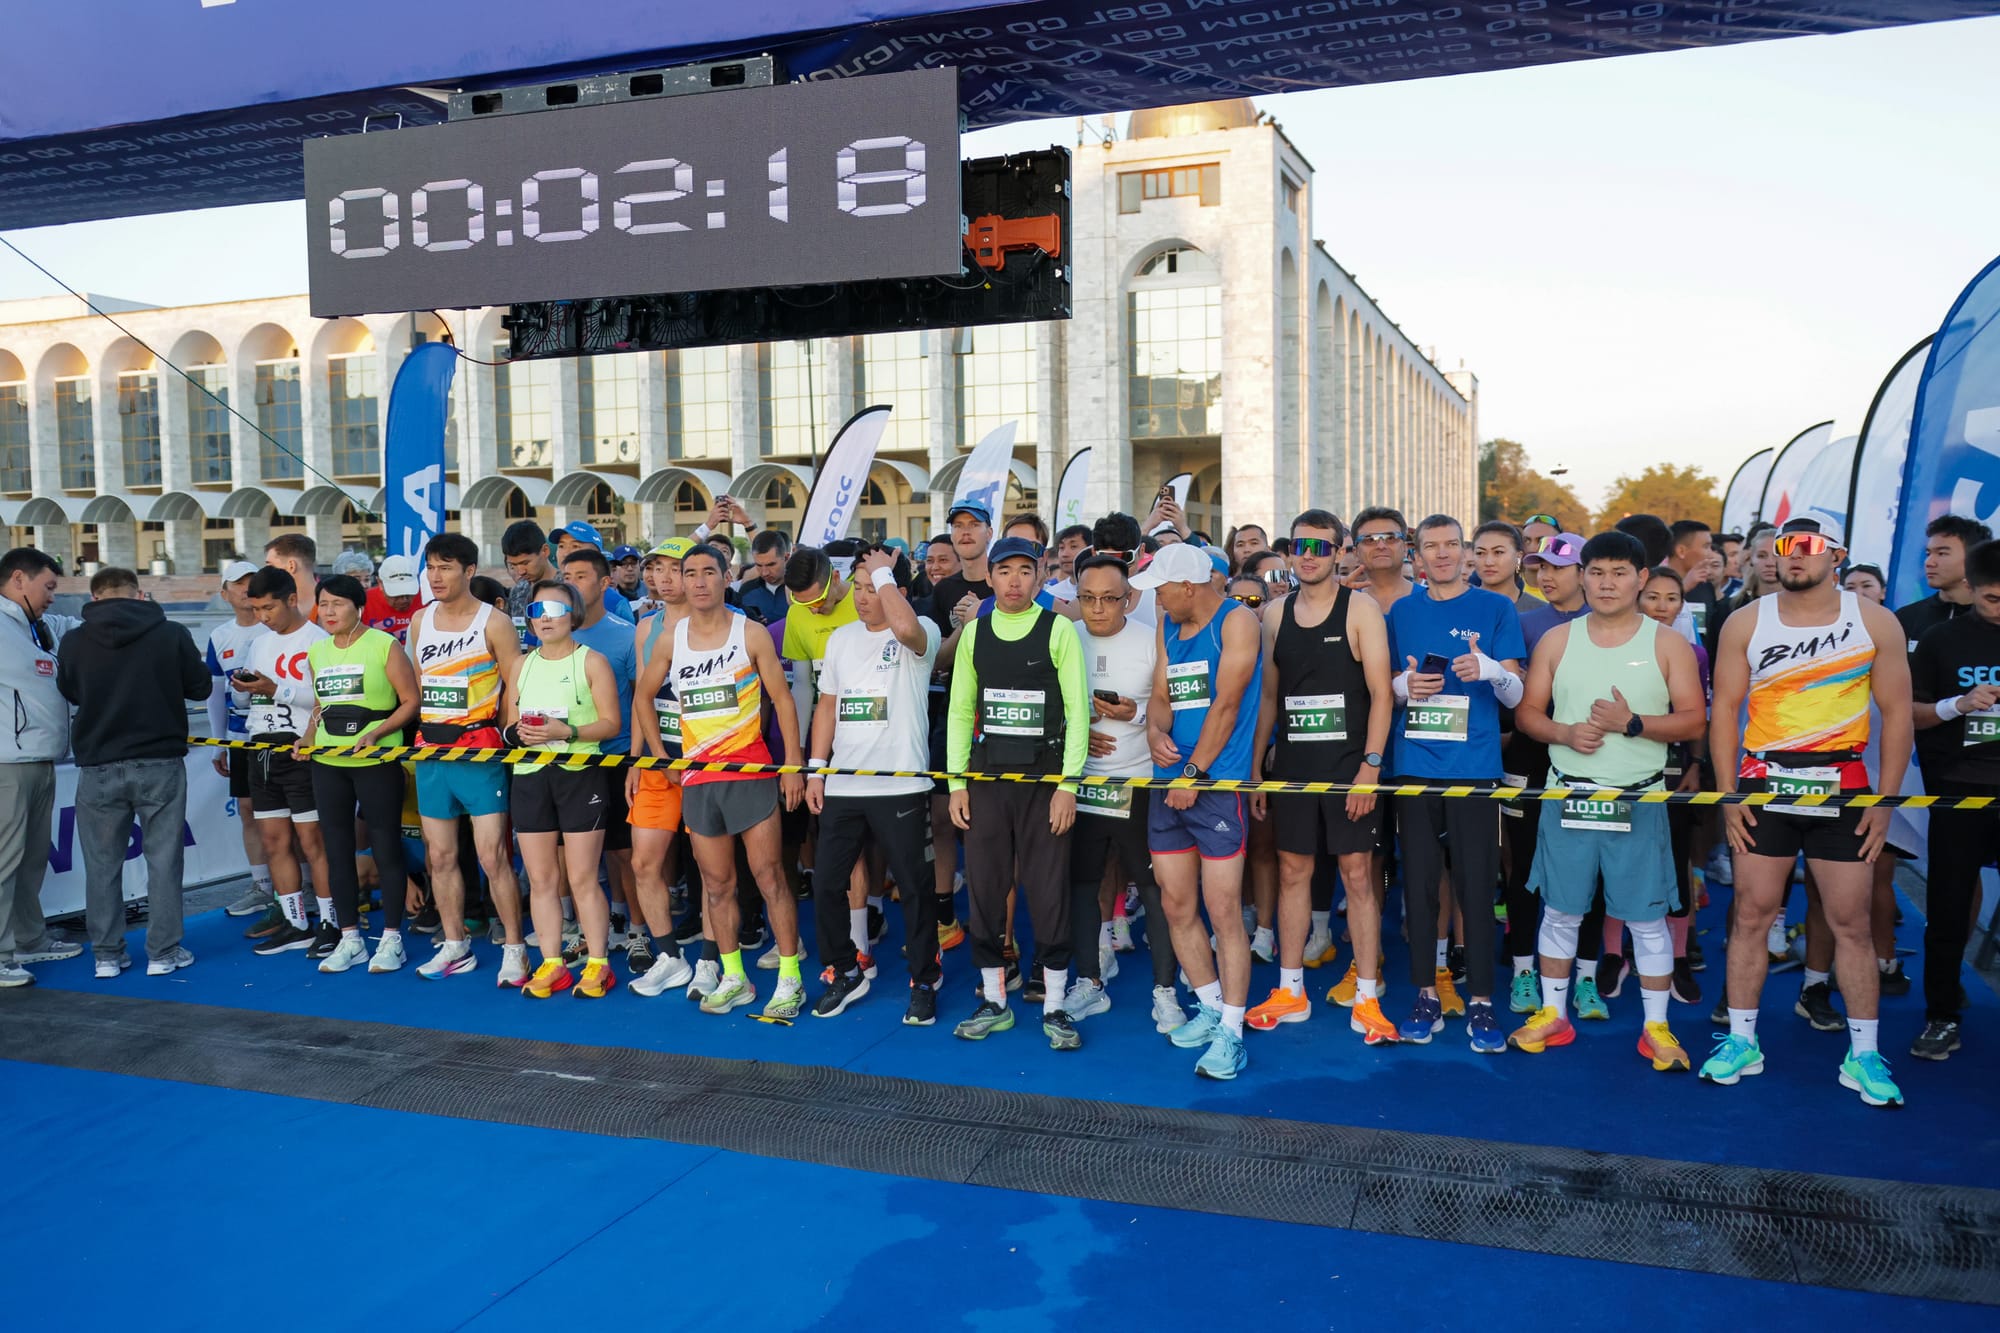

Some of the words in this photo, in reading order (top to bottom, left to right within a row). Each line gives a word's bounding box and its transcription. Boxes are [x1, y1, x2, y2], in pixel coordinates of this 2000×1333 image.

[1085, 3, 1173, 25] бег
[1006, 17, 1068, 35] со
[1103, 25, 1187, 46] бег
[305, 108, 357, 123] со
[136, 116, 304, 147] смыслом
[28, 147, 75, 159] со
[81, 138, 142, 153] бег
[316, 678, 353, 692] 1233
[1169, 679, 1201, 696] 1384
[423, 690, 458, 702] 1043
[683, 690, 726, 707] 1898
[840, 702, 874, 714] 1657
[986, 706, 1031, 720] 1260
[660, 716, 682, 729] 68
[1289, 713, 1327, 727] 1717
[1408, 711, 1453, 725] 1837
[1077, 785, 1120, 802] 1634
[1564, 800, 1614, 815] 1010
